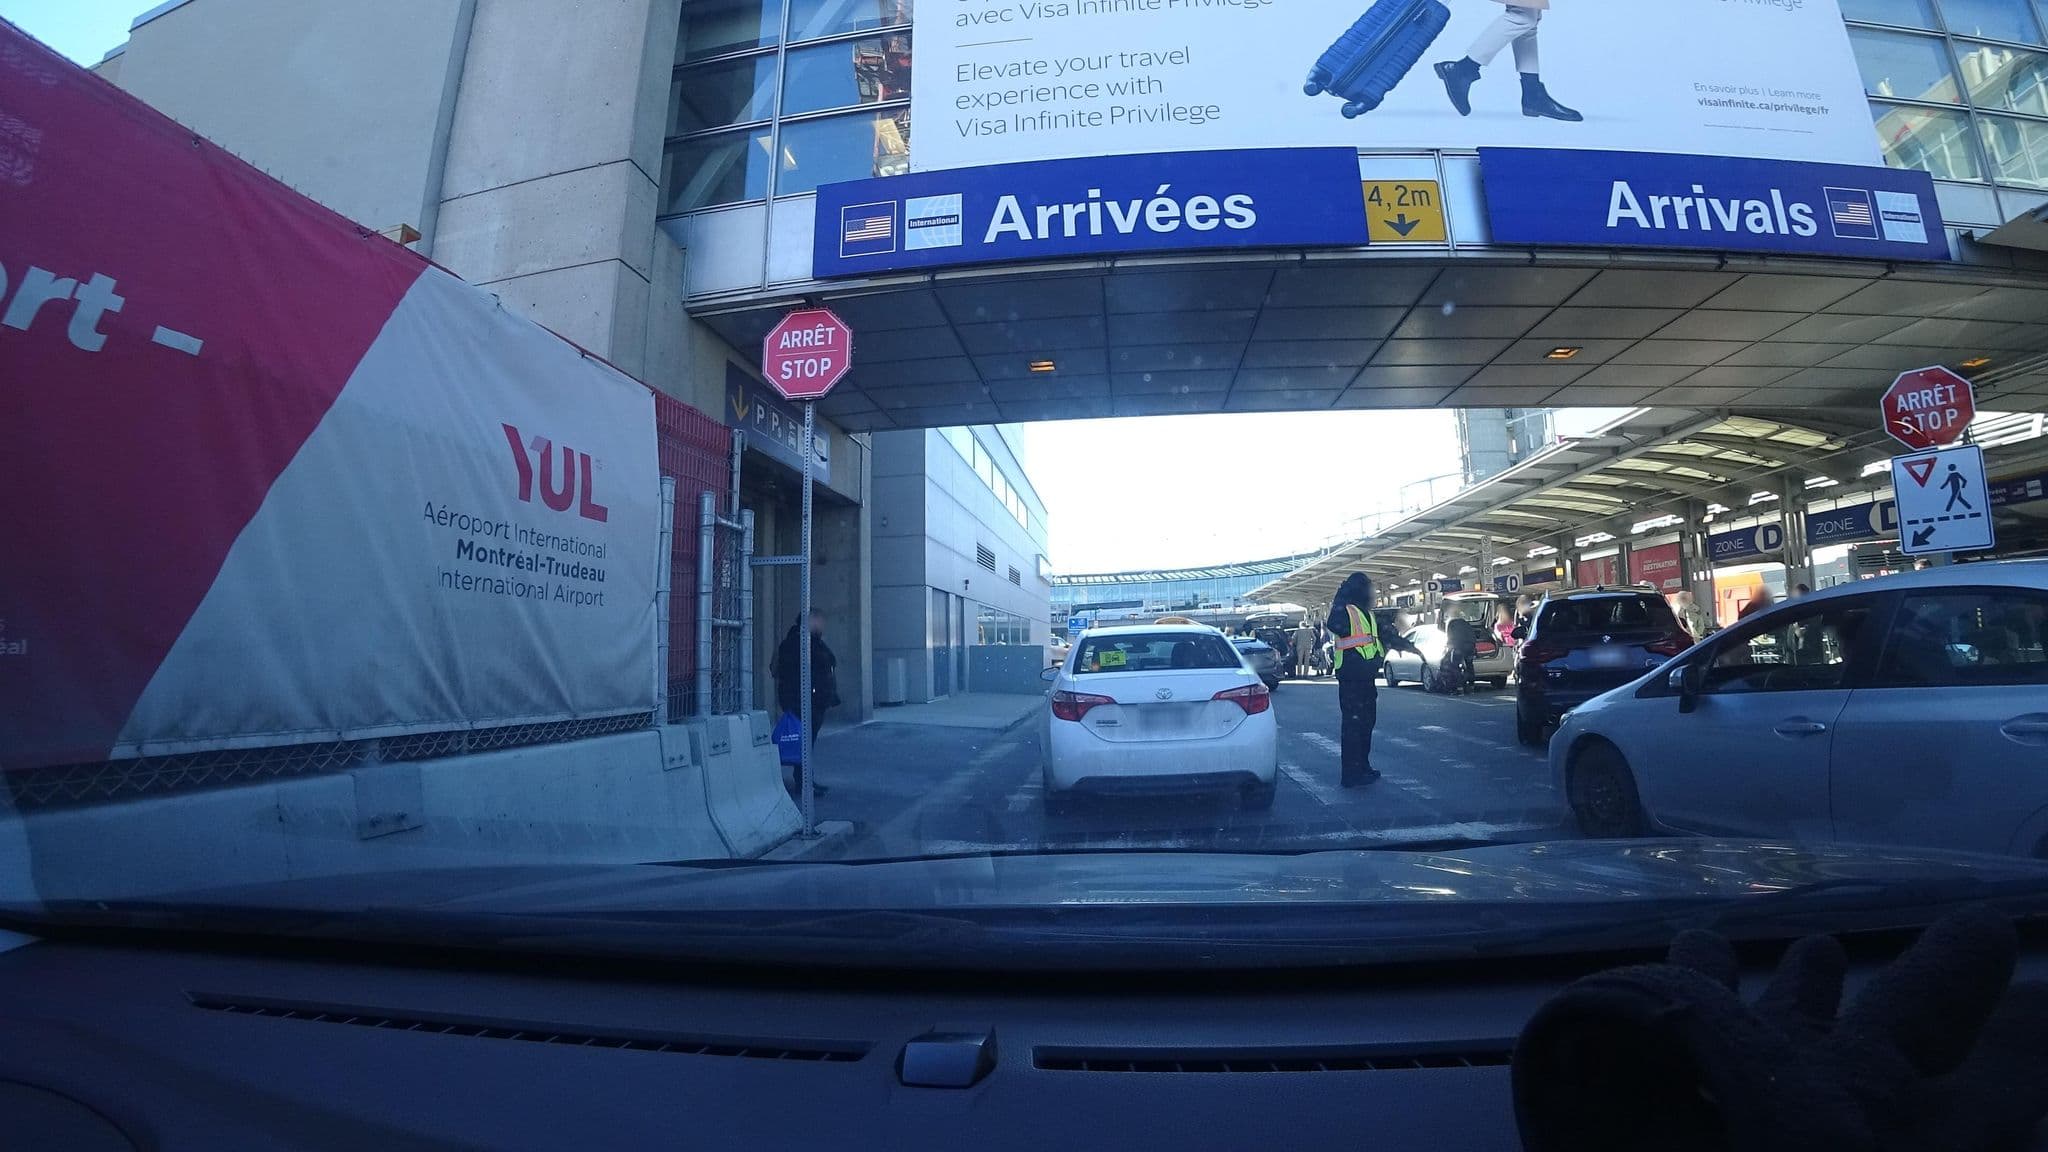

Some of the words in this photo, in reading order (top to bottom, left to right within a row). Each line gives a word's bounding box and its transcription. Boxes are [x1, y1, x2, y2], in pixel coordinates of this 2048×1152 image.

[956, 8, 1013, 27] avec
[1019, 2, 1069, 20] Visa
[957, 59, 1048, 82] Elevate
[1054, 54, 1112, 77] your
[1118, 45, 1190, 68] travel
[955, 83, 1099, 111] experience
[1106, 75, 1162, 96] with
[1694, 82, 1708, 92] En
[1708, 84, 1736, 94] savoir
[1739, 85, 1759, 96] plus
[1768, 87, 1795, 98] Learn
[1796, 91, 1821, 101] more
[956, 118, 1007, 137] Visa
[1015, 109, 1103, 132] Infinite
[1110, 102, 1220, 125] Privilege
[1697, 97, 1829, 115] visainfinite.ca/privilege/fr
[1368, 184, 1431, 212] 4,2m
[1606, 180, 1818, 237] Arrivals
[909, 215, 958, 228] International
[983, 183, 1257, 244] Arrivées
[779, 323, 836, 350] ARRÊT
[780, 357, 832, 380] STOP
[1897, 383, 1956, 413] ARRÊT
[1902, 408, 1959, 435] STOP
[501, 422, 608, 523] YUL
[423, 501, 510, 540] Aéroport
[514, 523, 607, 559] International
[1715, 538, 1745, 553] ZONE
[1763, 524, 1783, 550] D
[1815, 517, 1855, 536] ZONE
[456, 538, 605, 582] Montréal-Trudeau
[437, 565, 549, 601] International
[553, 583, 604, 607] Airport
[1427, 581, 1438, 592] D
[1509, 575, 1519, 592] D
